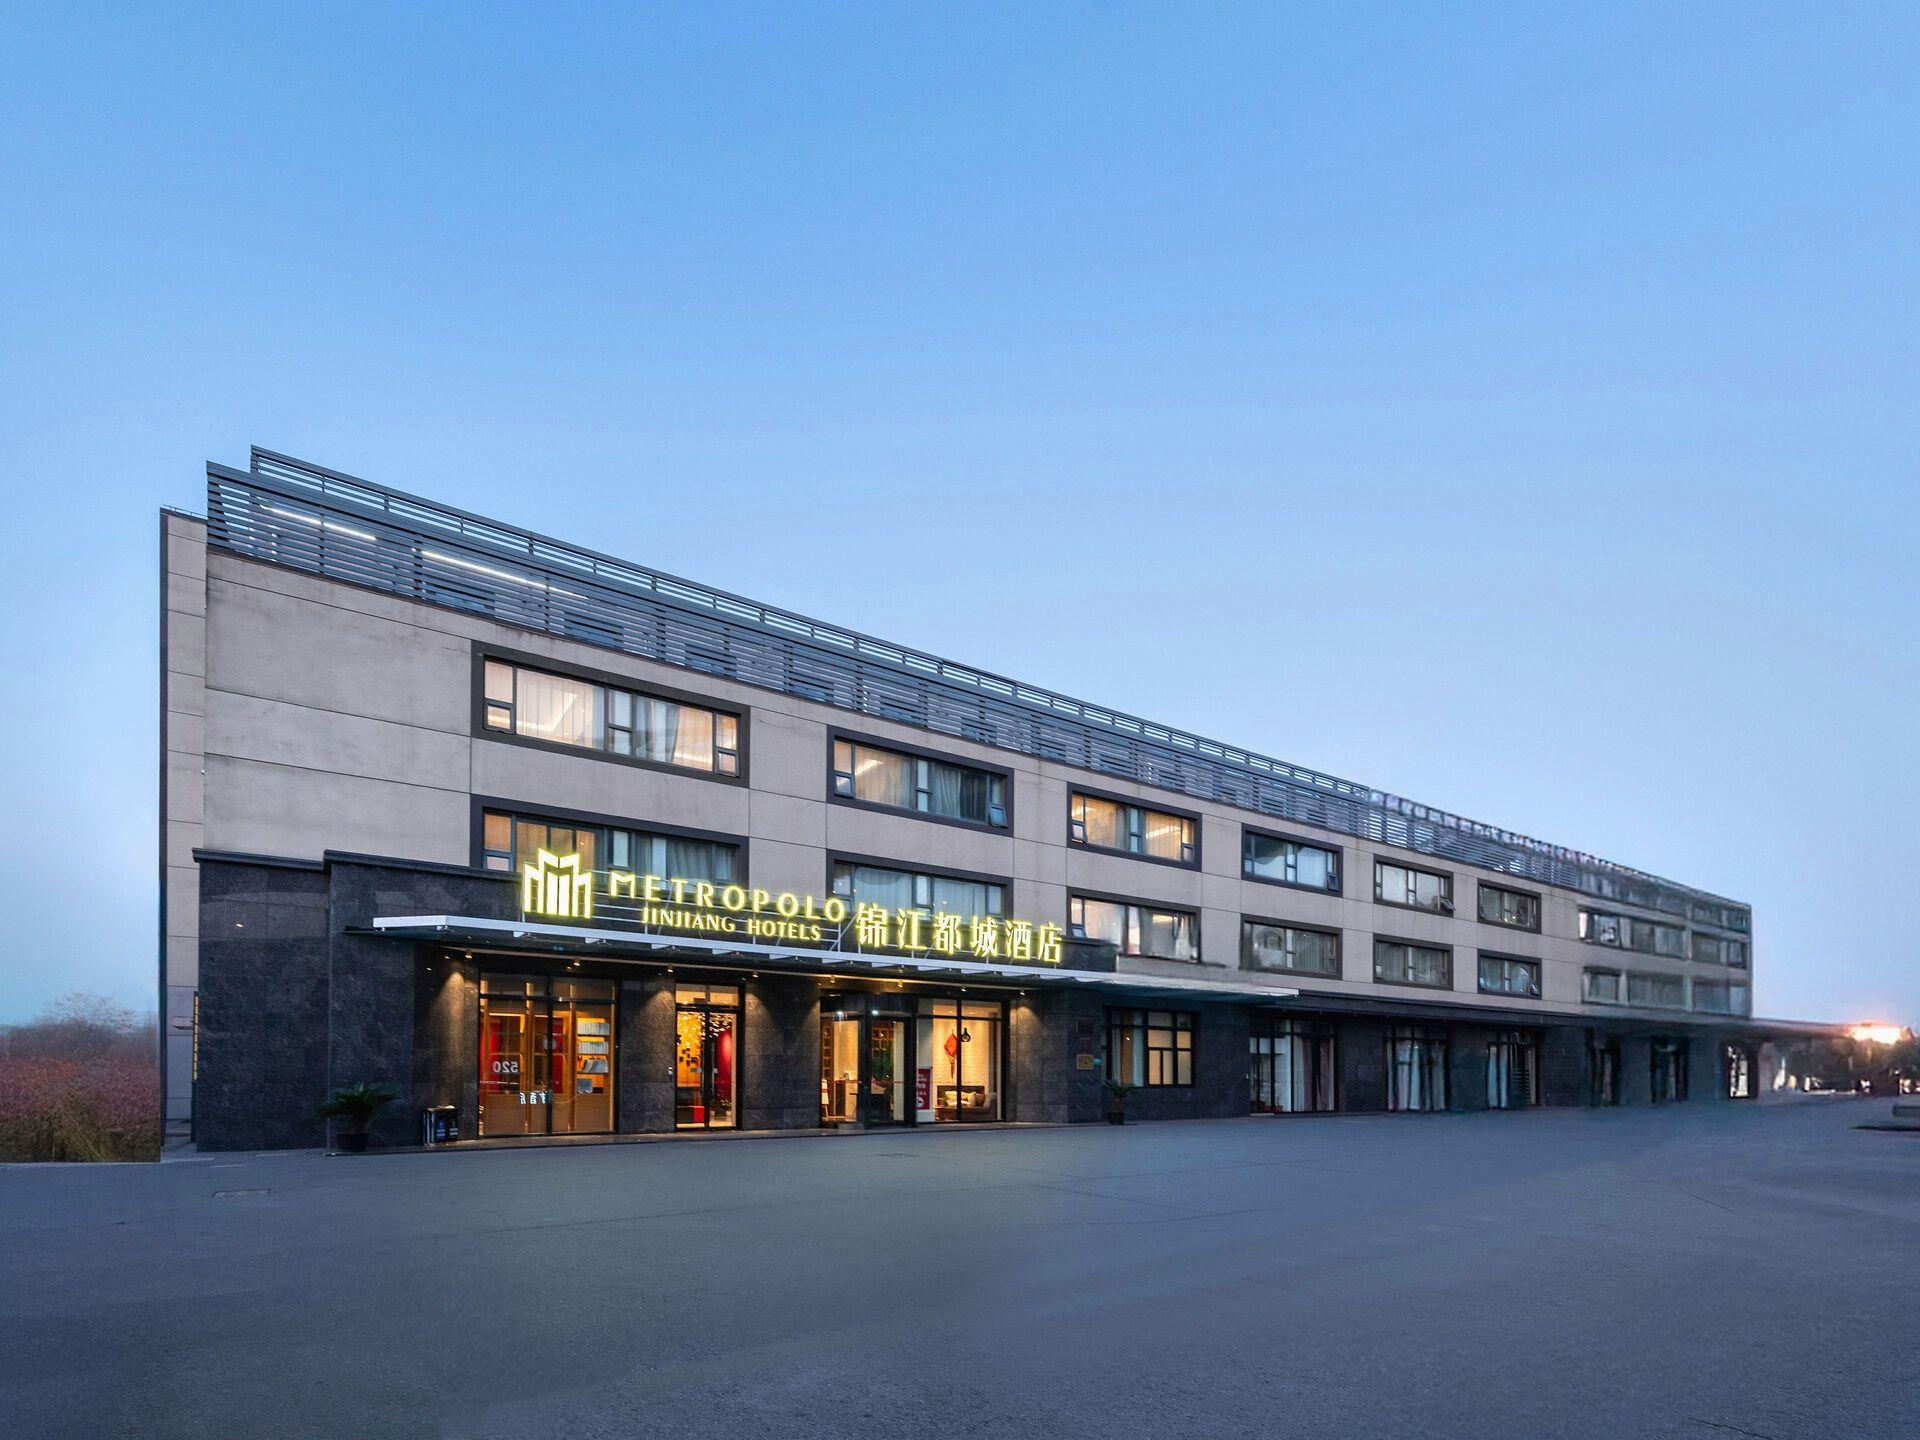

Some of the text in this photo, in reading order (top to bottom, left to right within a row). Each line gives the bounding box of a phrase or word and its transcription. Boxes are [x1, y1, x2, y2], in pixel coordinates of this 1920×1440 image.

[609, 871, 845, 922] METROPOLO
[641, 907, 821, 940] JINJIANG HOTELS
[856, 902, 1063, 963] 锦江都城酒店
